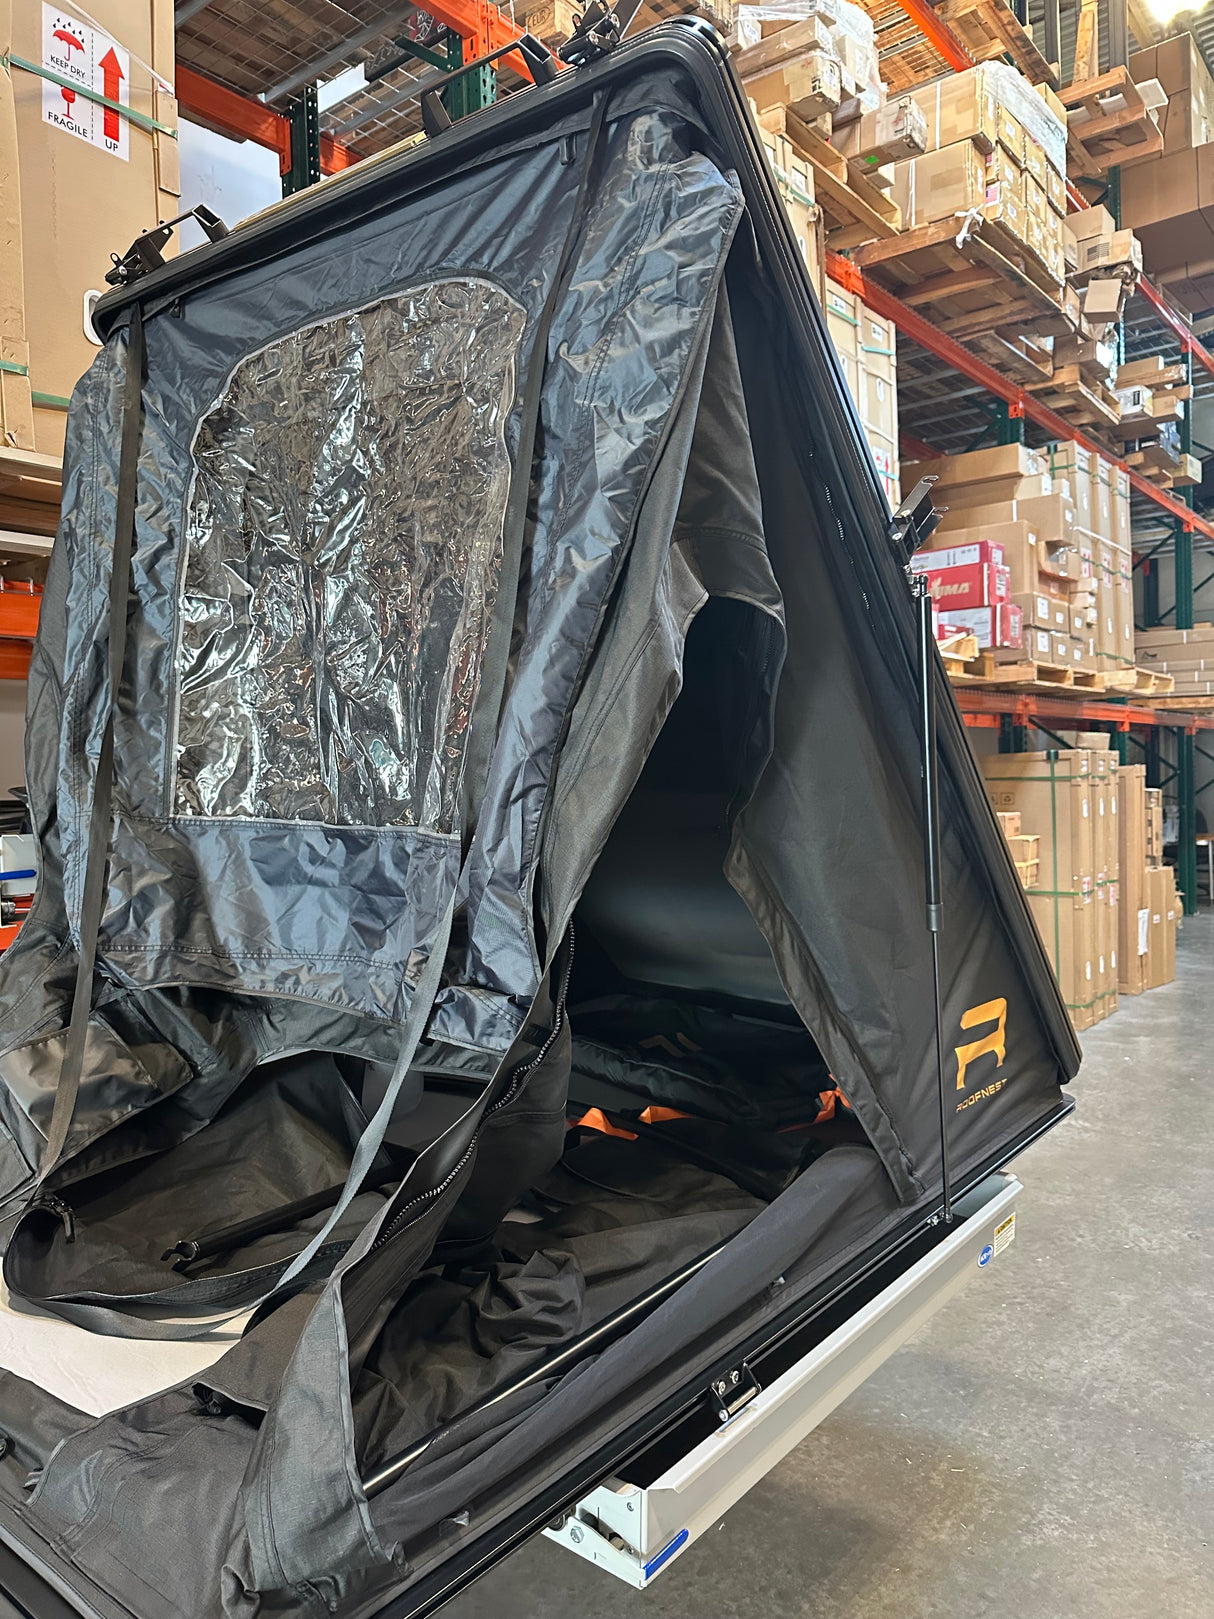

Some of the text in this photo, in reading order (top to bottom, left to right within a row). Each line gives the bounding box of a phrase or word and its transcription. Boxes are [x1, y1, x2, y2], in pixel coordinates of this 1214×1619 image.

[50, 55, 86, 79] KEEP DRY
[48, 111, 88, 138] FRAGILE
[105, 138, 119, 152] UP
[955, 1078, 1008, 1113] ROOFNEST
